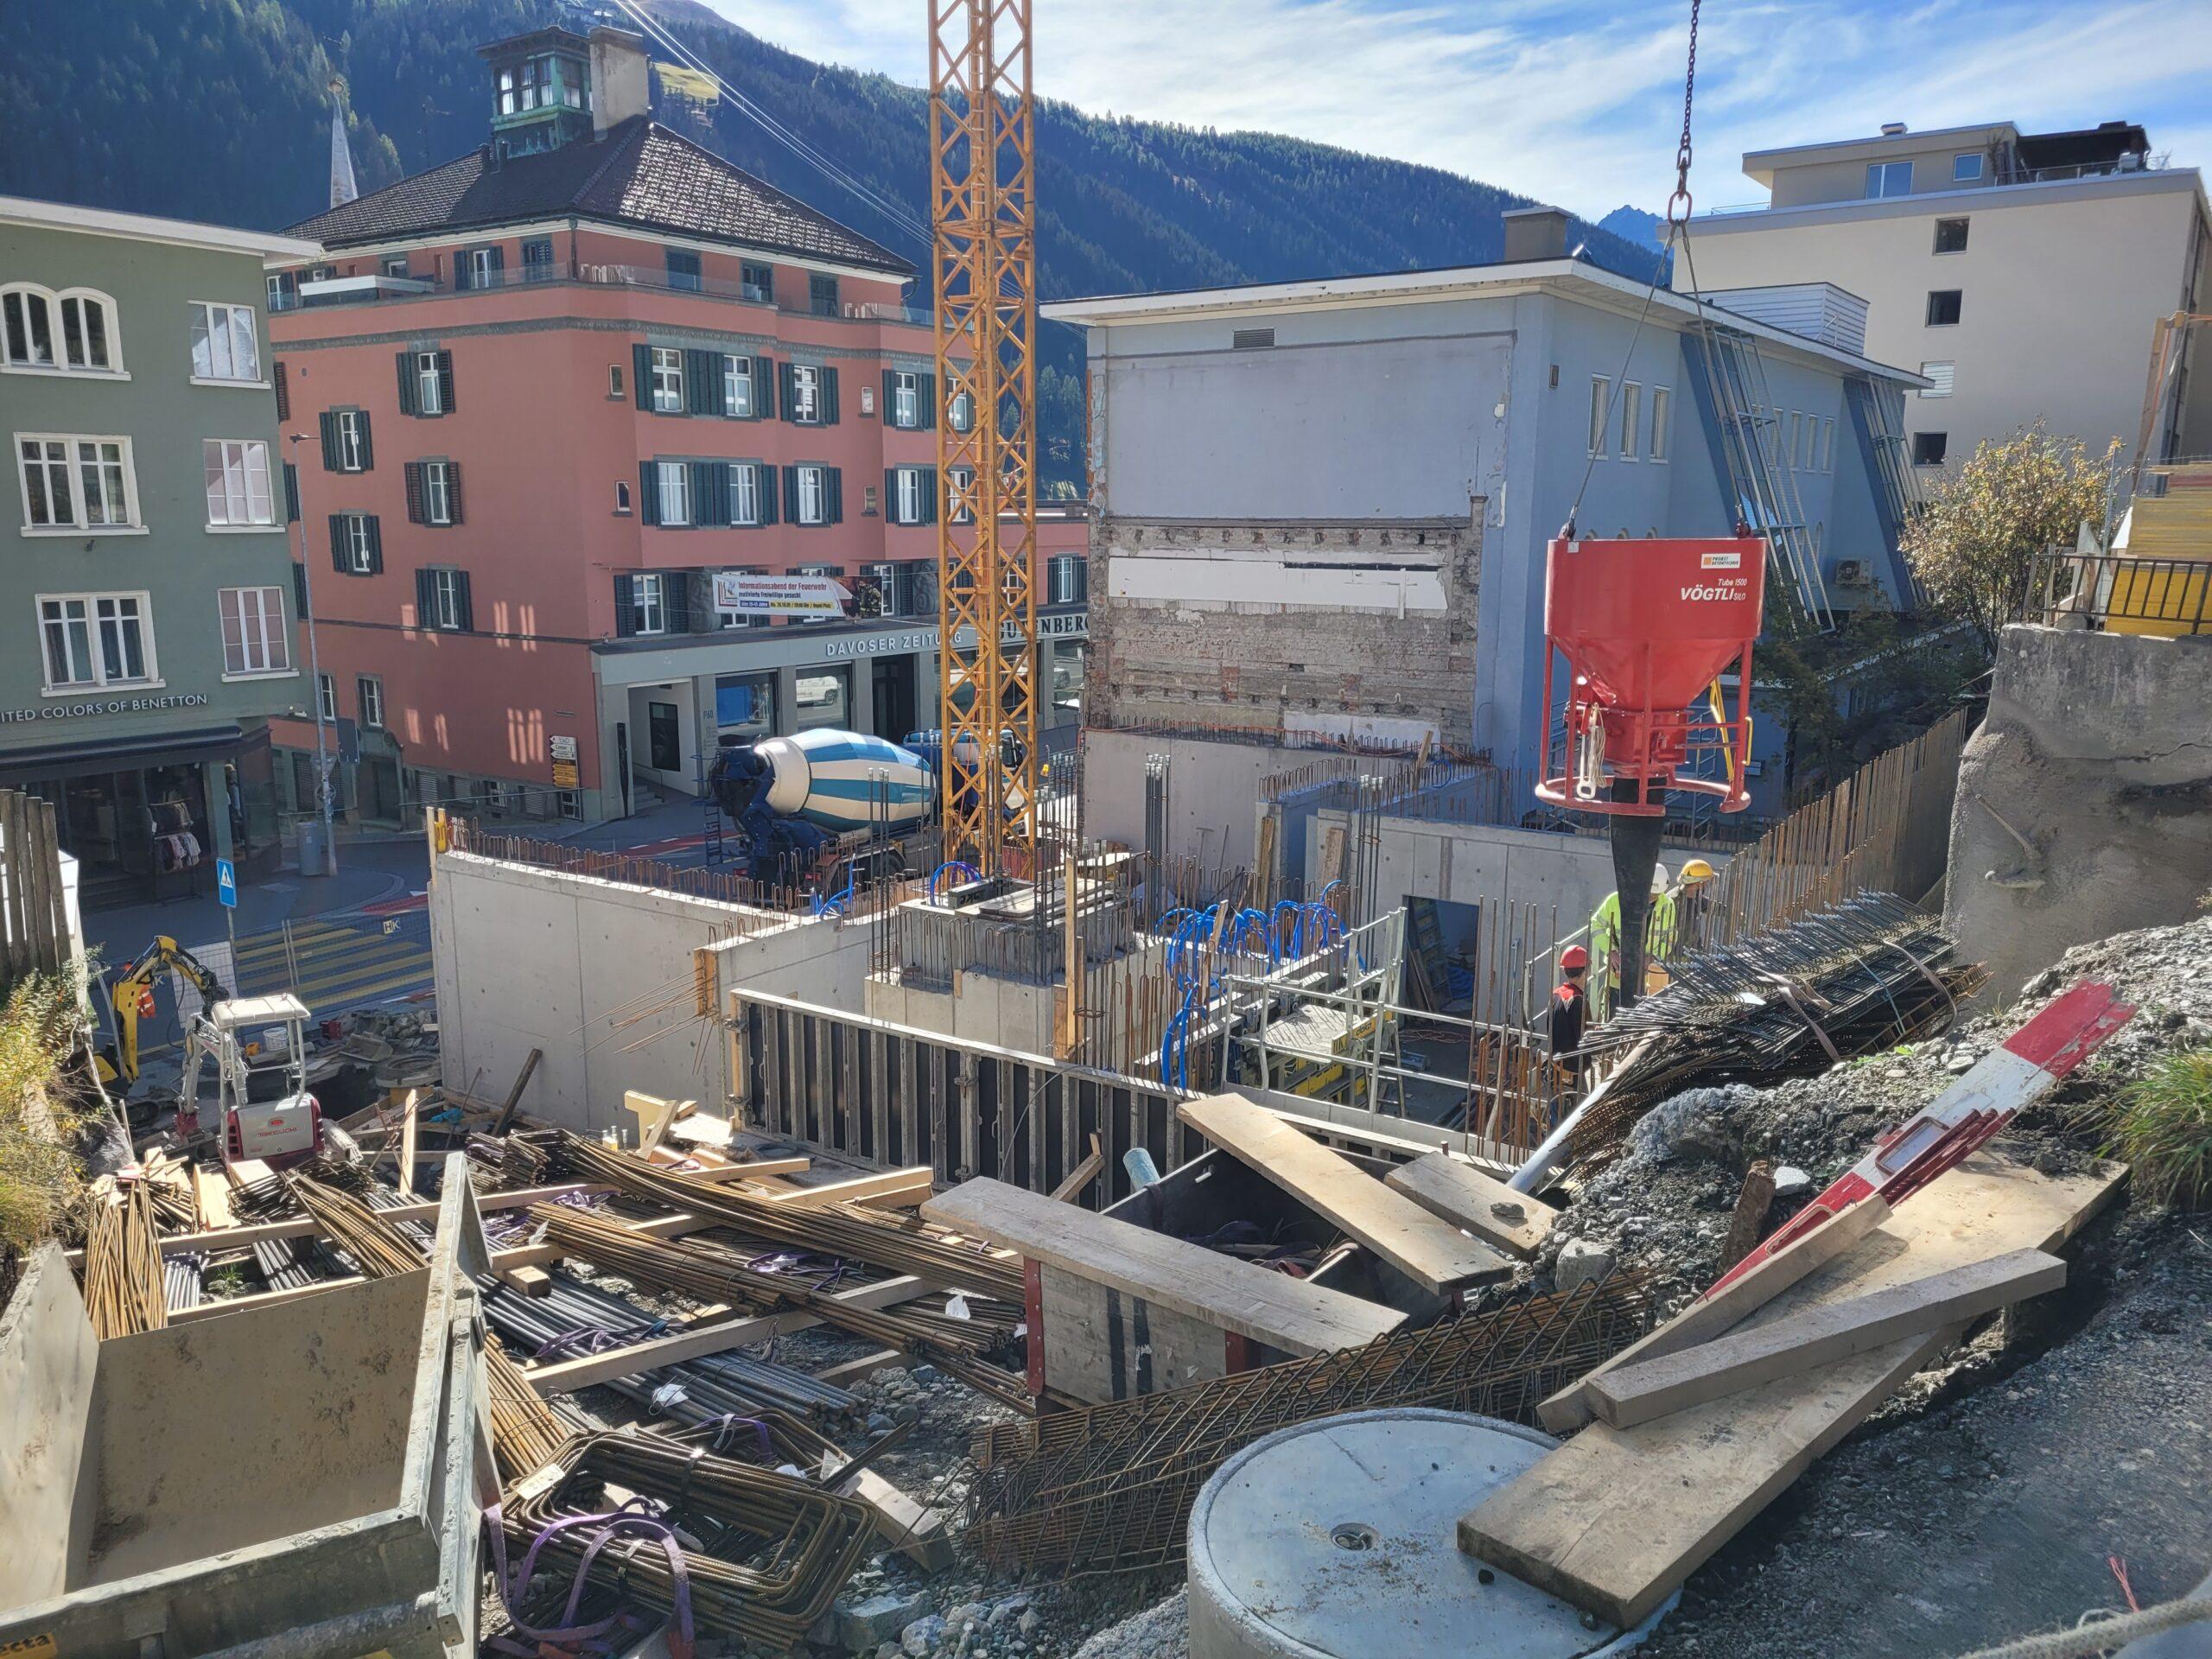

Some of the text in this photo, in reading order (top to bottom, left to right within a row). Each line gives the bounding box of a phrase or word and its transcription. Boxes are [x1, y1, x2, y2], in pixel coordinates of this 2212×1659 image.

[738, 582, 787, 590] Informationsabend
[798, 582, 827, 591] Feuerwehr
[1718, 578, 1748, 587] Tube 1500
[1681, 584, 1734, 601] VÖGTLI
[826, 632, 962, 657] DAVOSER ZEITUG
[41, 703, 103, 719] COLORS
[107, 701, 127, 713] OF
